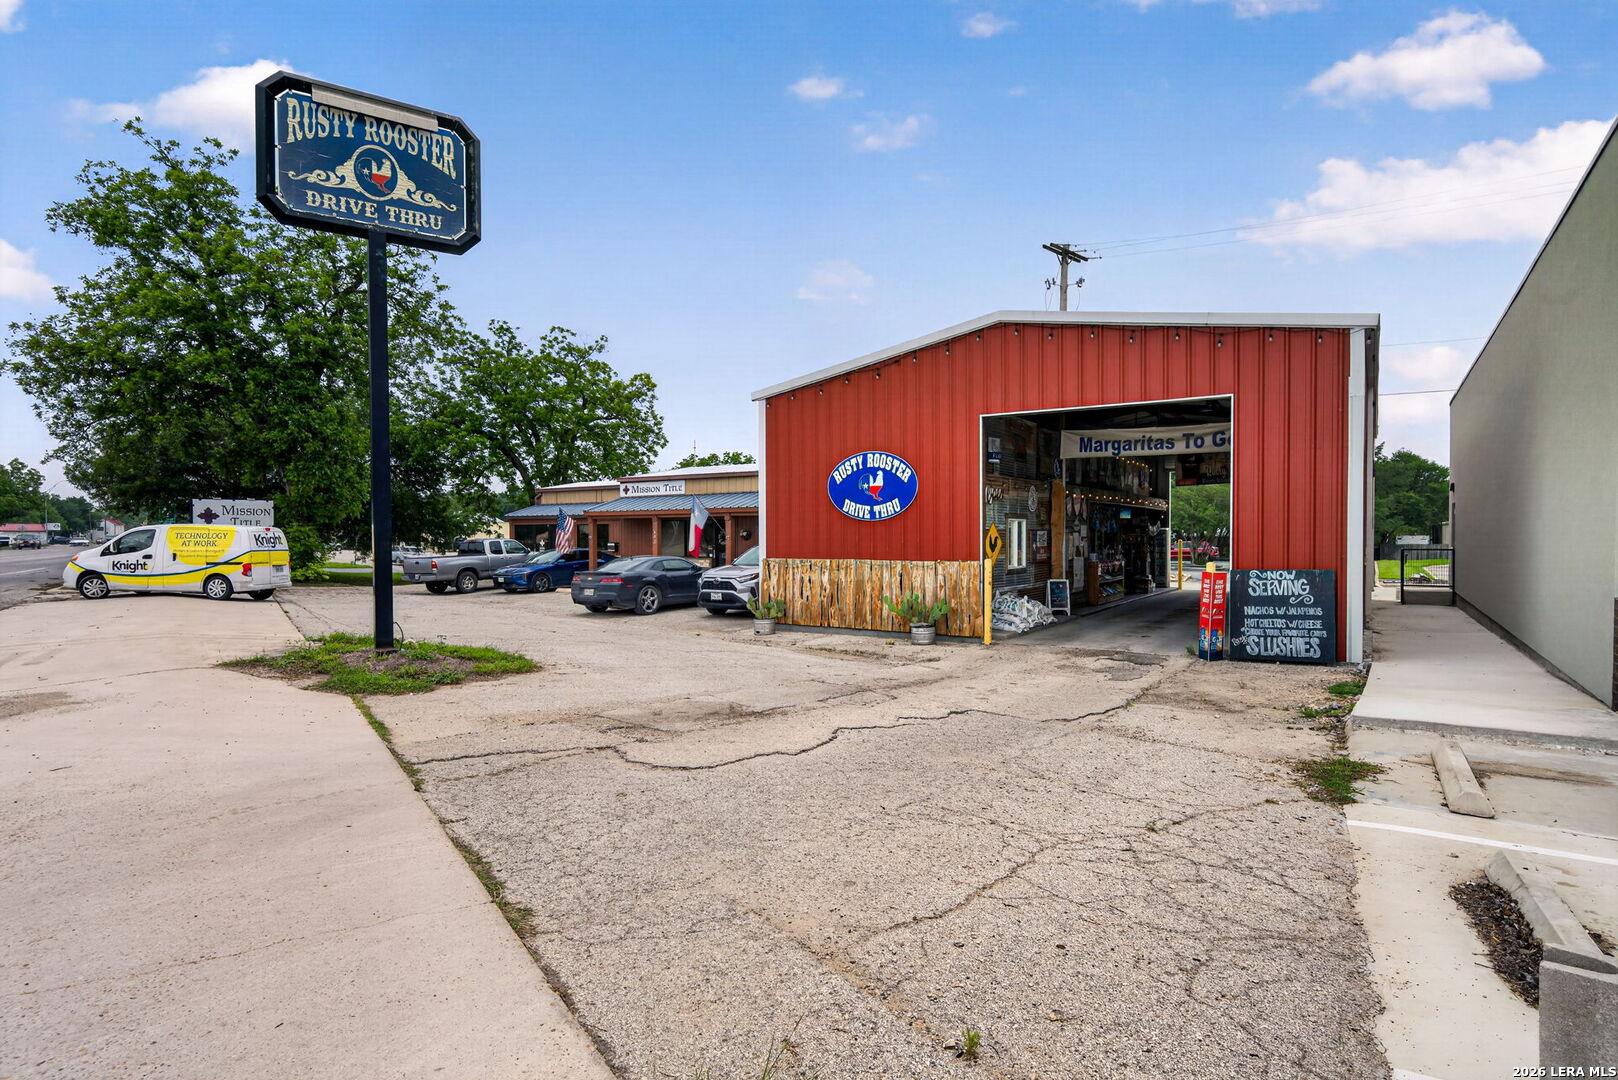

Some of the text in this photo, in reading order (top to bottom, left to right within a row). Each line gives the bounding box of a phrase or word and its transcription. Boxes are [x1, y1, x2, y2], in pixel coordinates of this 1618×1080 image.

[287, 97, 456, 180] RUSTY ROOSTER
[305, 190, 443, 231] DRIVE THRU
[1079, 435, 1175, 456] Margaritas
[1182, 433, 1205, 449] To
[832, 453, 912, 485] RUSTY ROOSTER
[631, 485, 660, 494] MISSION
[221, 505, 271, 516] MISSION
[842, 497, 901, 519] DRIVE THRU
[175, 532, 228, 540] TECHNOLOGY
[254, 532, 283, 548] Knight
[112, 559, 148, 573] Knight
[1267, 570, 1296, 580] NOW
[1248, 578, 1310, 596] SERVING
[1244, 606, 1274, 615] NACHOS
[1244, 618, 1259, 628] HOT
[1298, 620, 1323, 629] CHEESE
[1246, 635, 1321, 658] SLUSHIES
